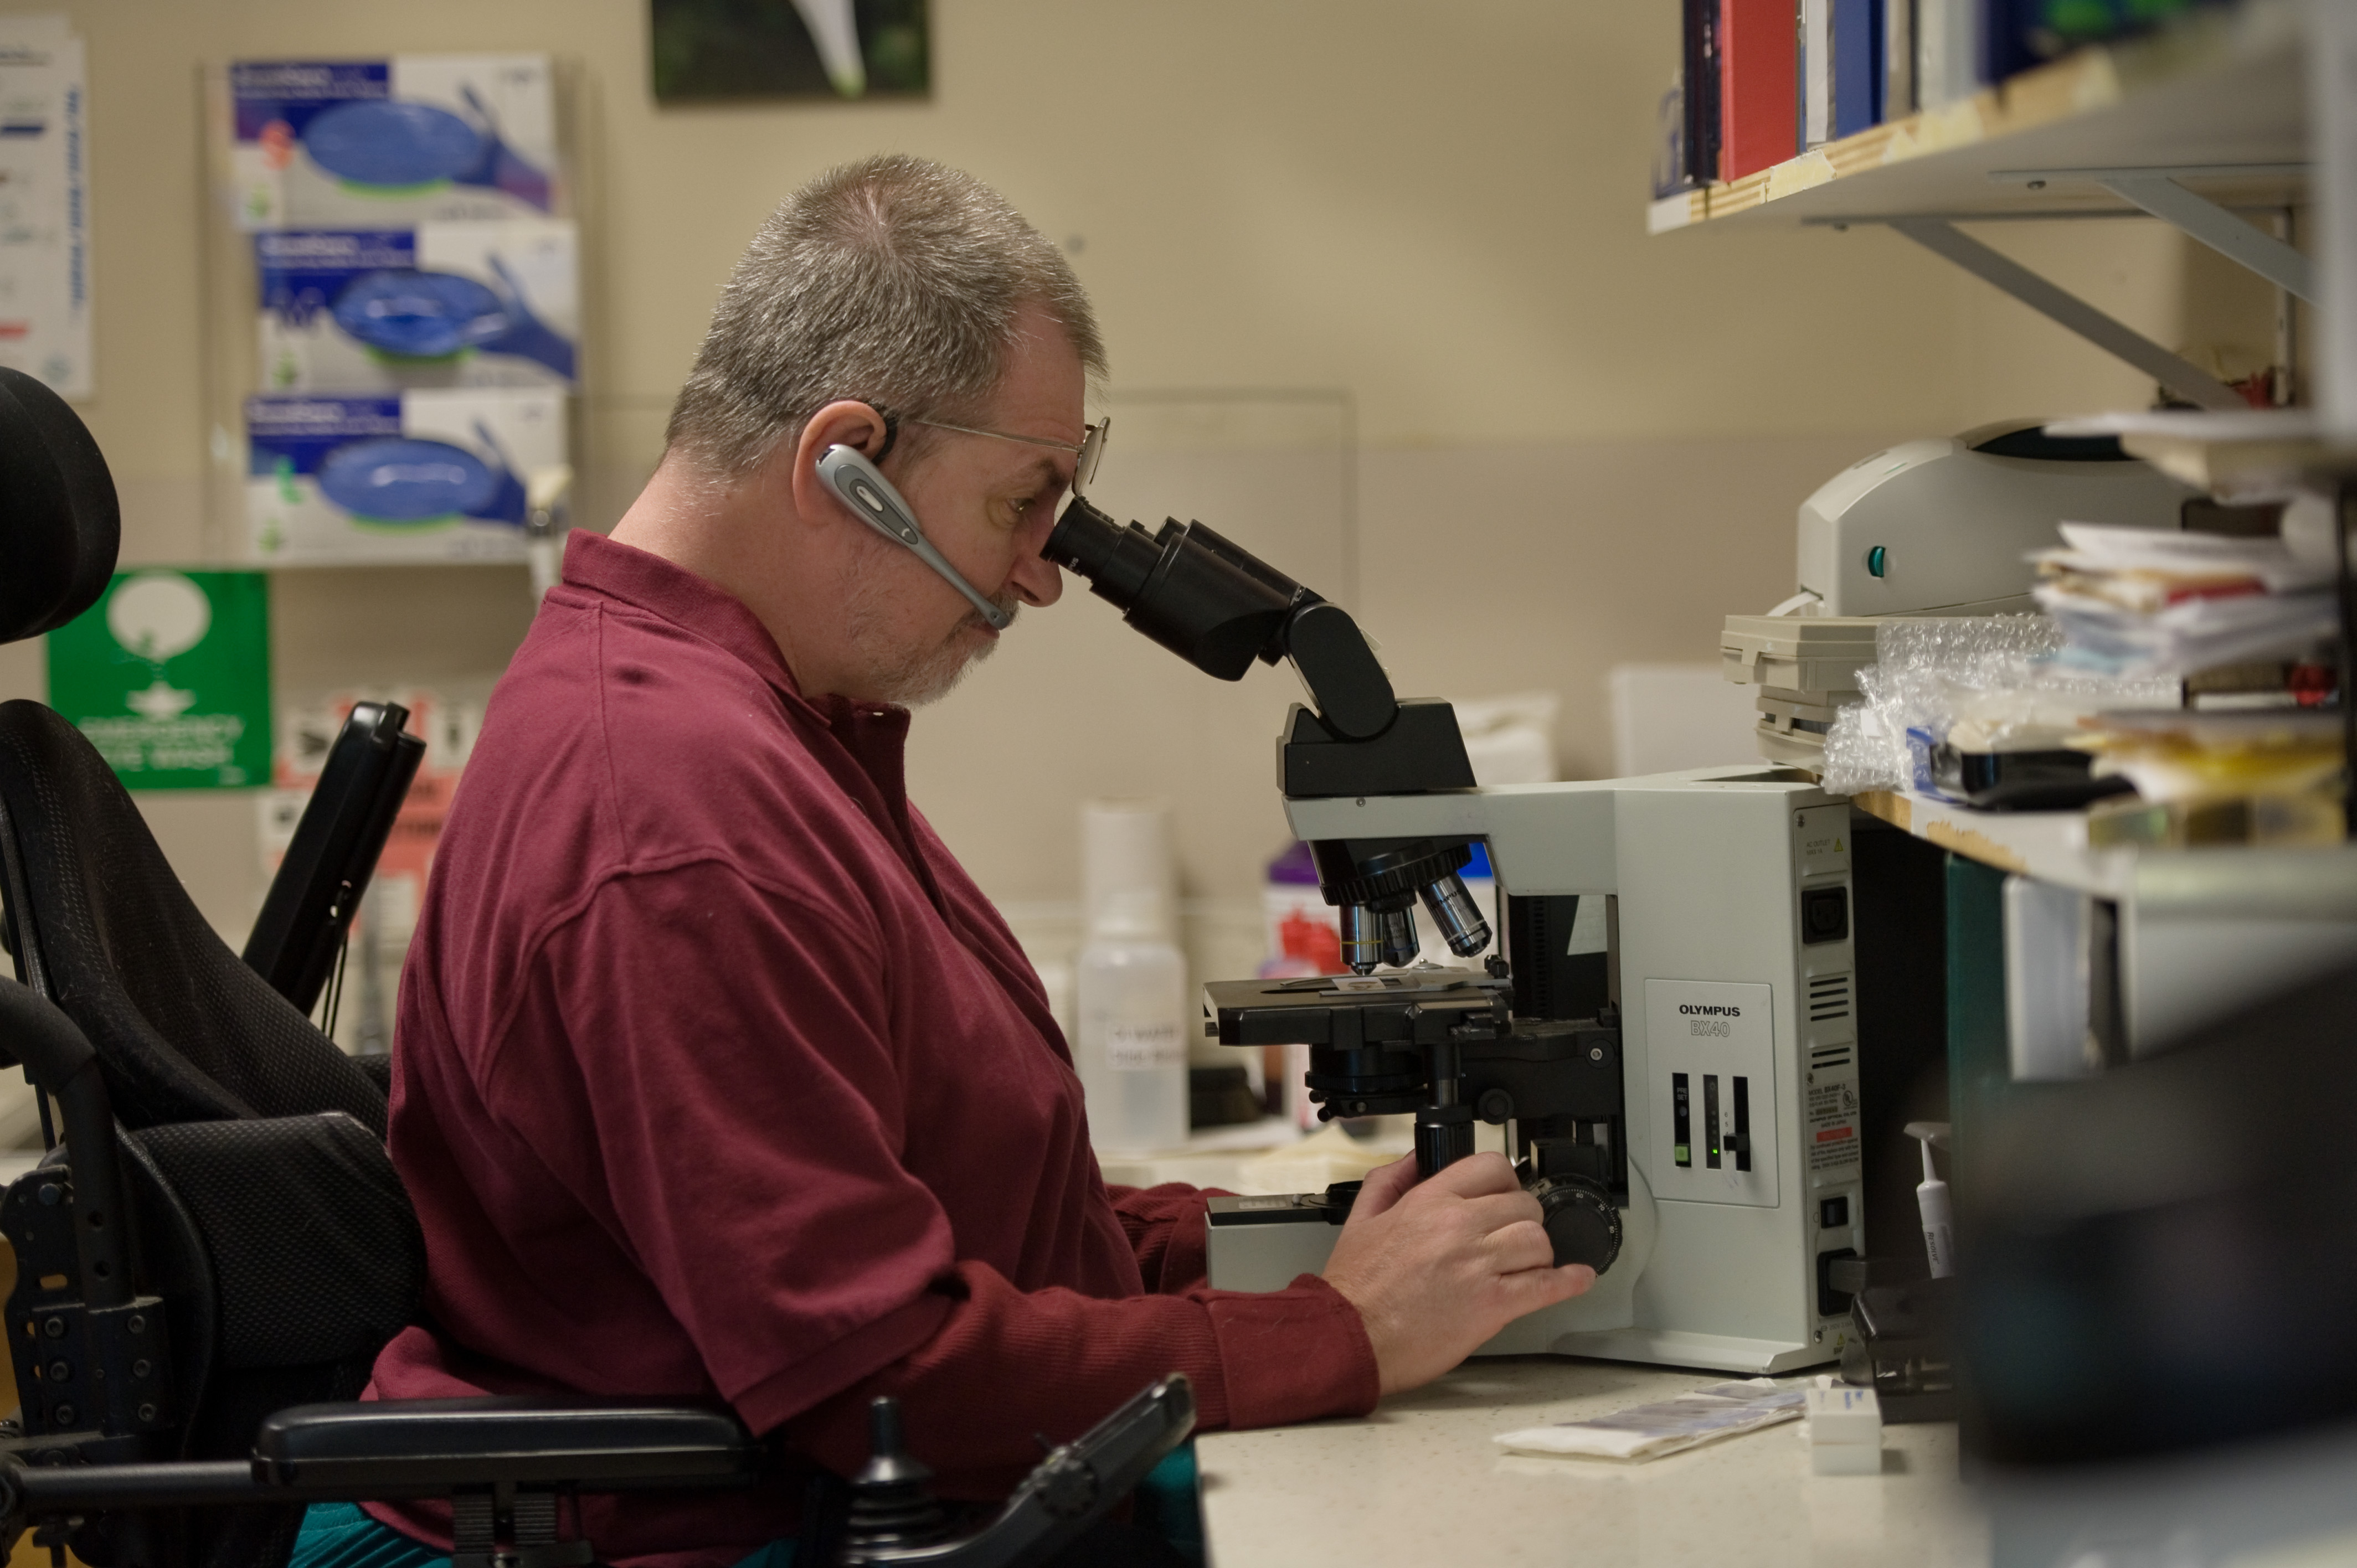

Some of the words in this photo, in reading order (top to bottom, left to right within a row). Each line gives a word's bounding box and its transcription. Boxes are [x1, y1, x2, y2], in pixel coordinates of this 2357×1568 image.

[1813, 839, 1830, 847] OUTLET
[1679, 1004, 1741, 1017] OLYMPUS
[1691, 1020, 1731, 1038] BX40
[1927, 1232, 1938, 1262] RESOLVE
